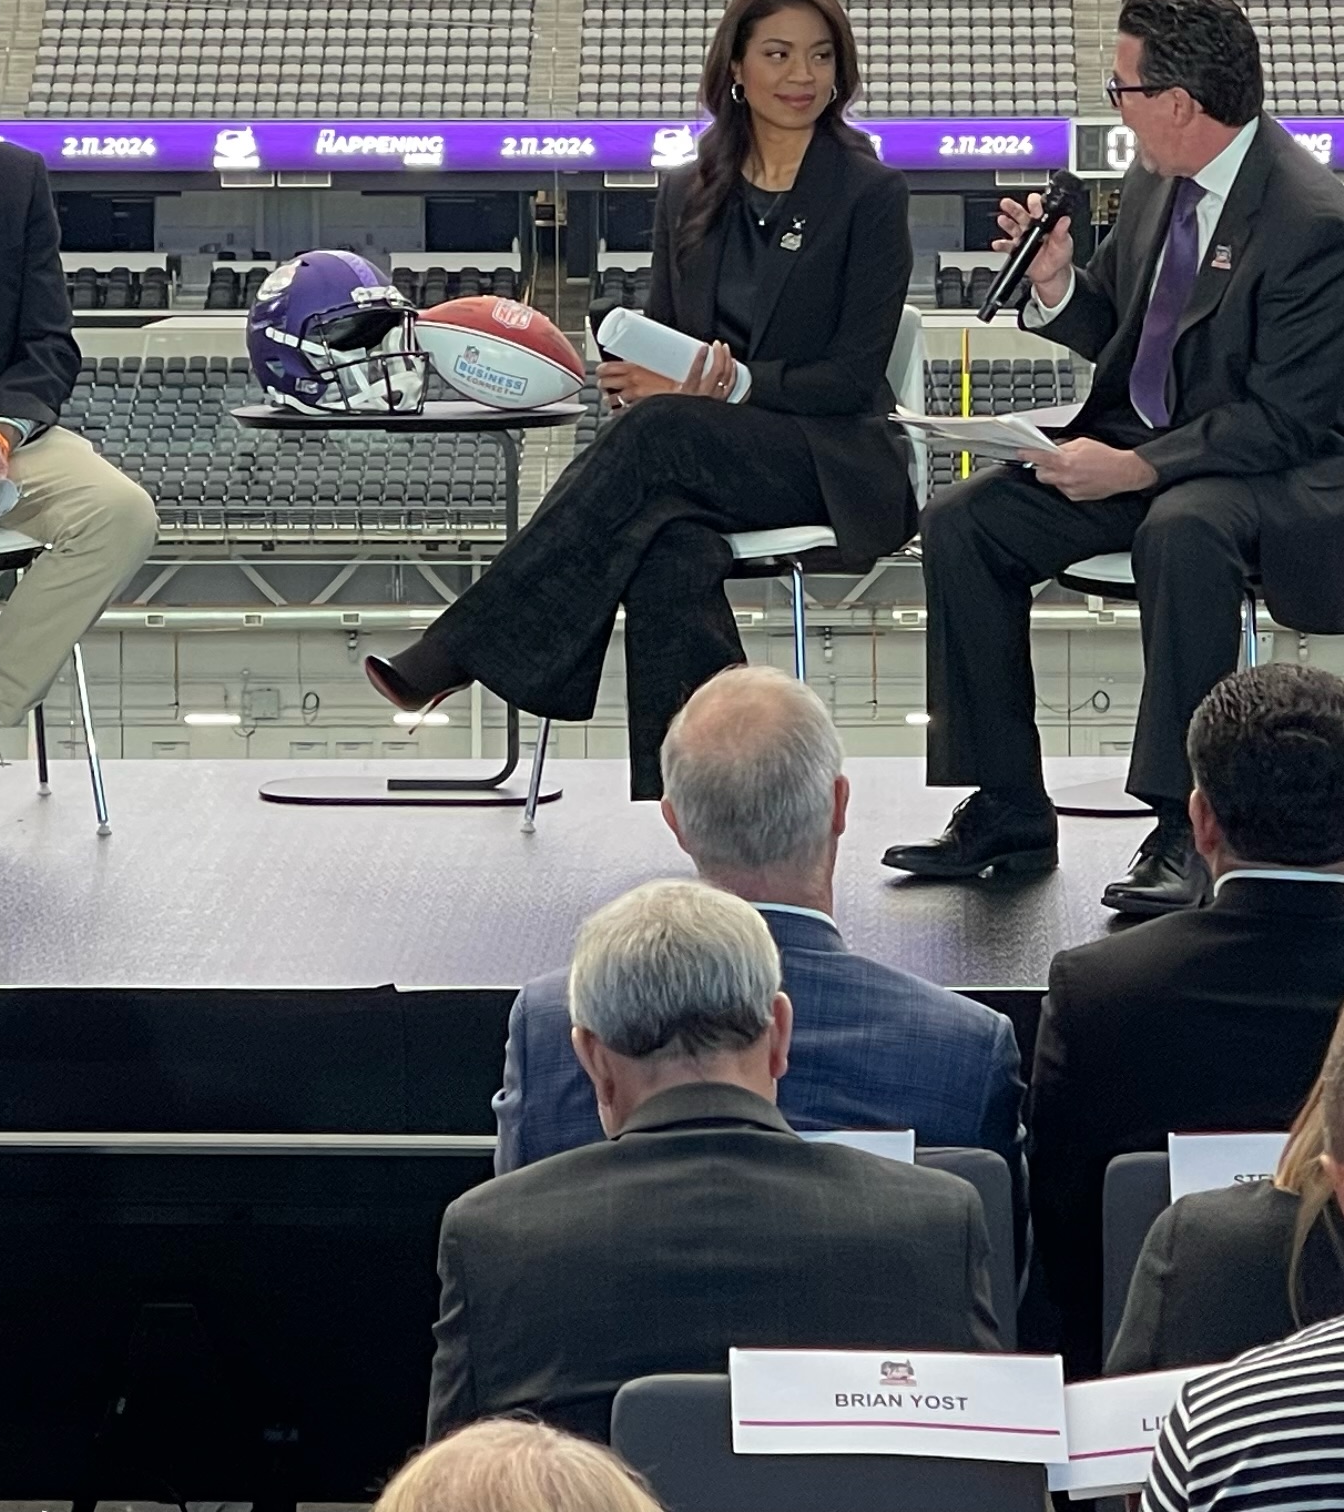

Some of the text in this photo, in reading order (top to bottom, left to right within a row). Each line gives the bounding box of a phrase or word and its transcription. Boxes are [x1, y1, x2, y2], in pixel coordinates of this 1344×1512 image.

[459, 361, 523, 390] BUSINESS
[835, 1393, 968, 1411] BRIAN YOST
